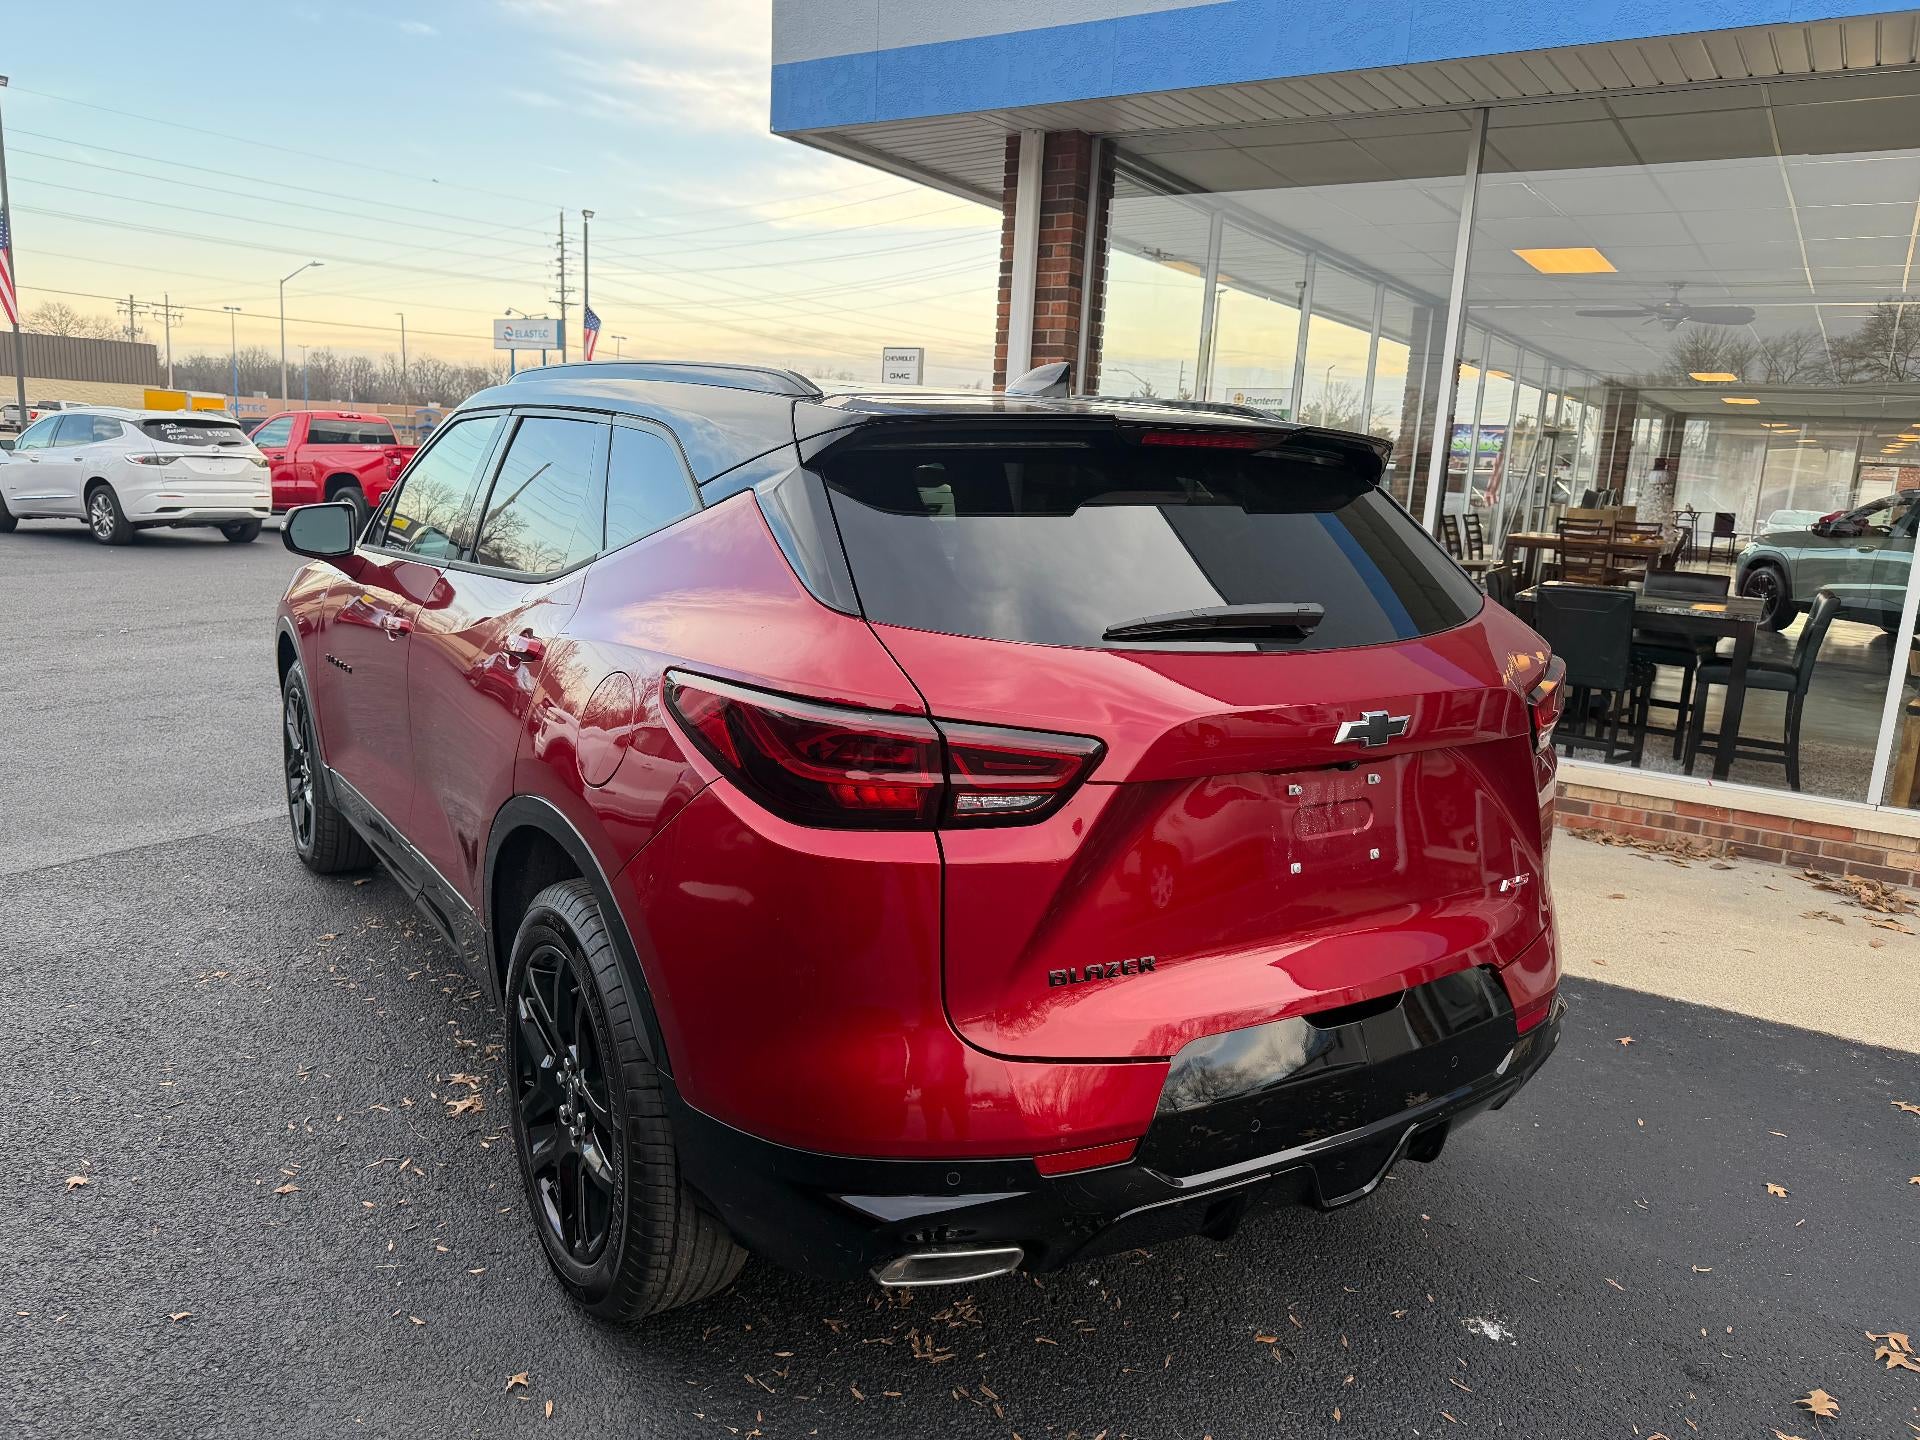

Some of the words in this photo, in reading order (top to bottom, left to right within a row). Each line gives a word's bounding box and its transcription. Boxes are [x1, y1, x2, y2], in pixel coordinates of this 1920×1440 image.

[515, 329, 549, 338] ELASTEC
[1245, 396, 1283, 405] Banterra
[1048, 956, 1156, 987] BLAZER
